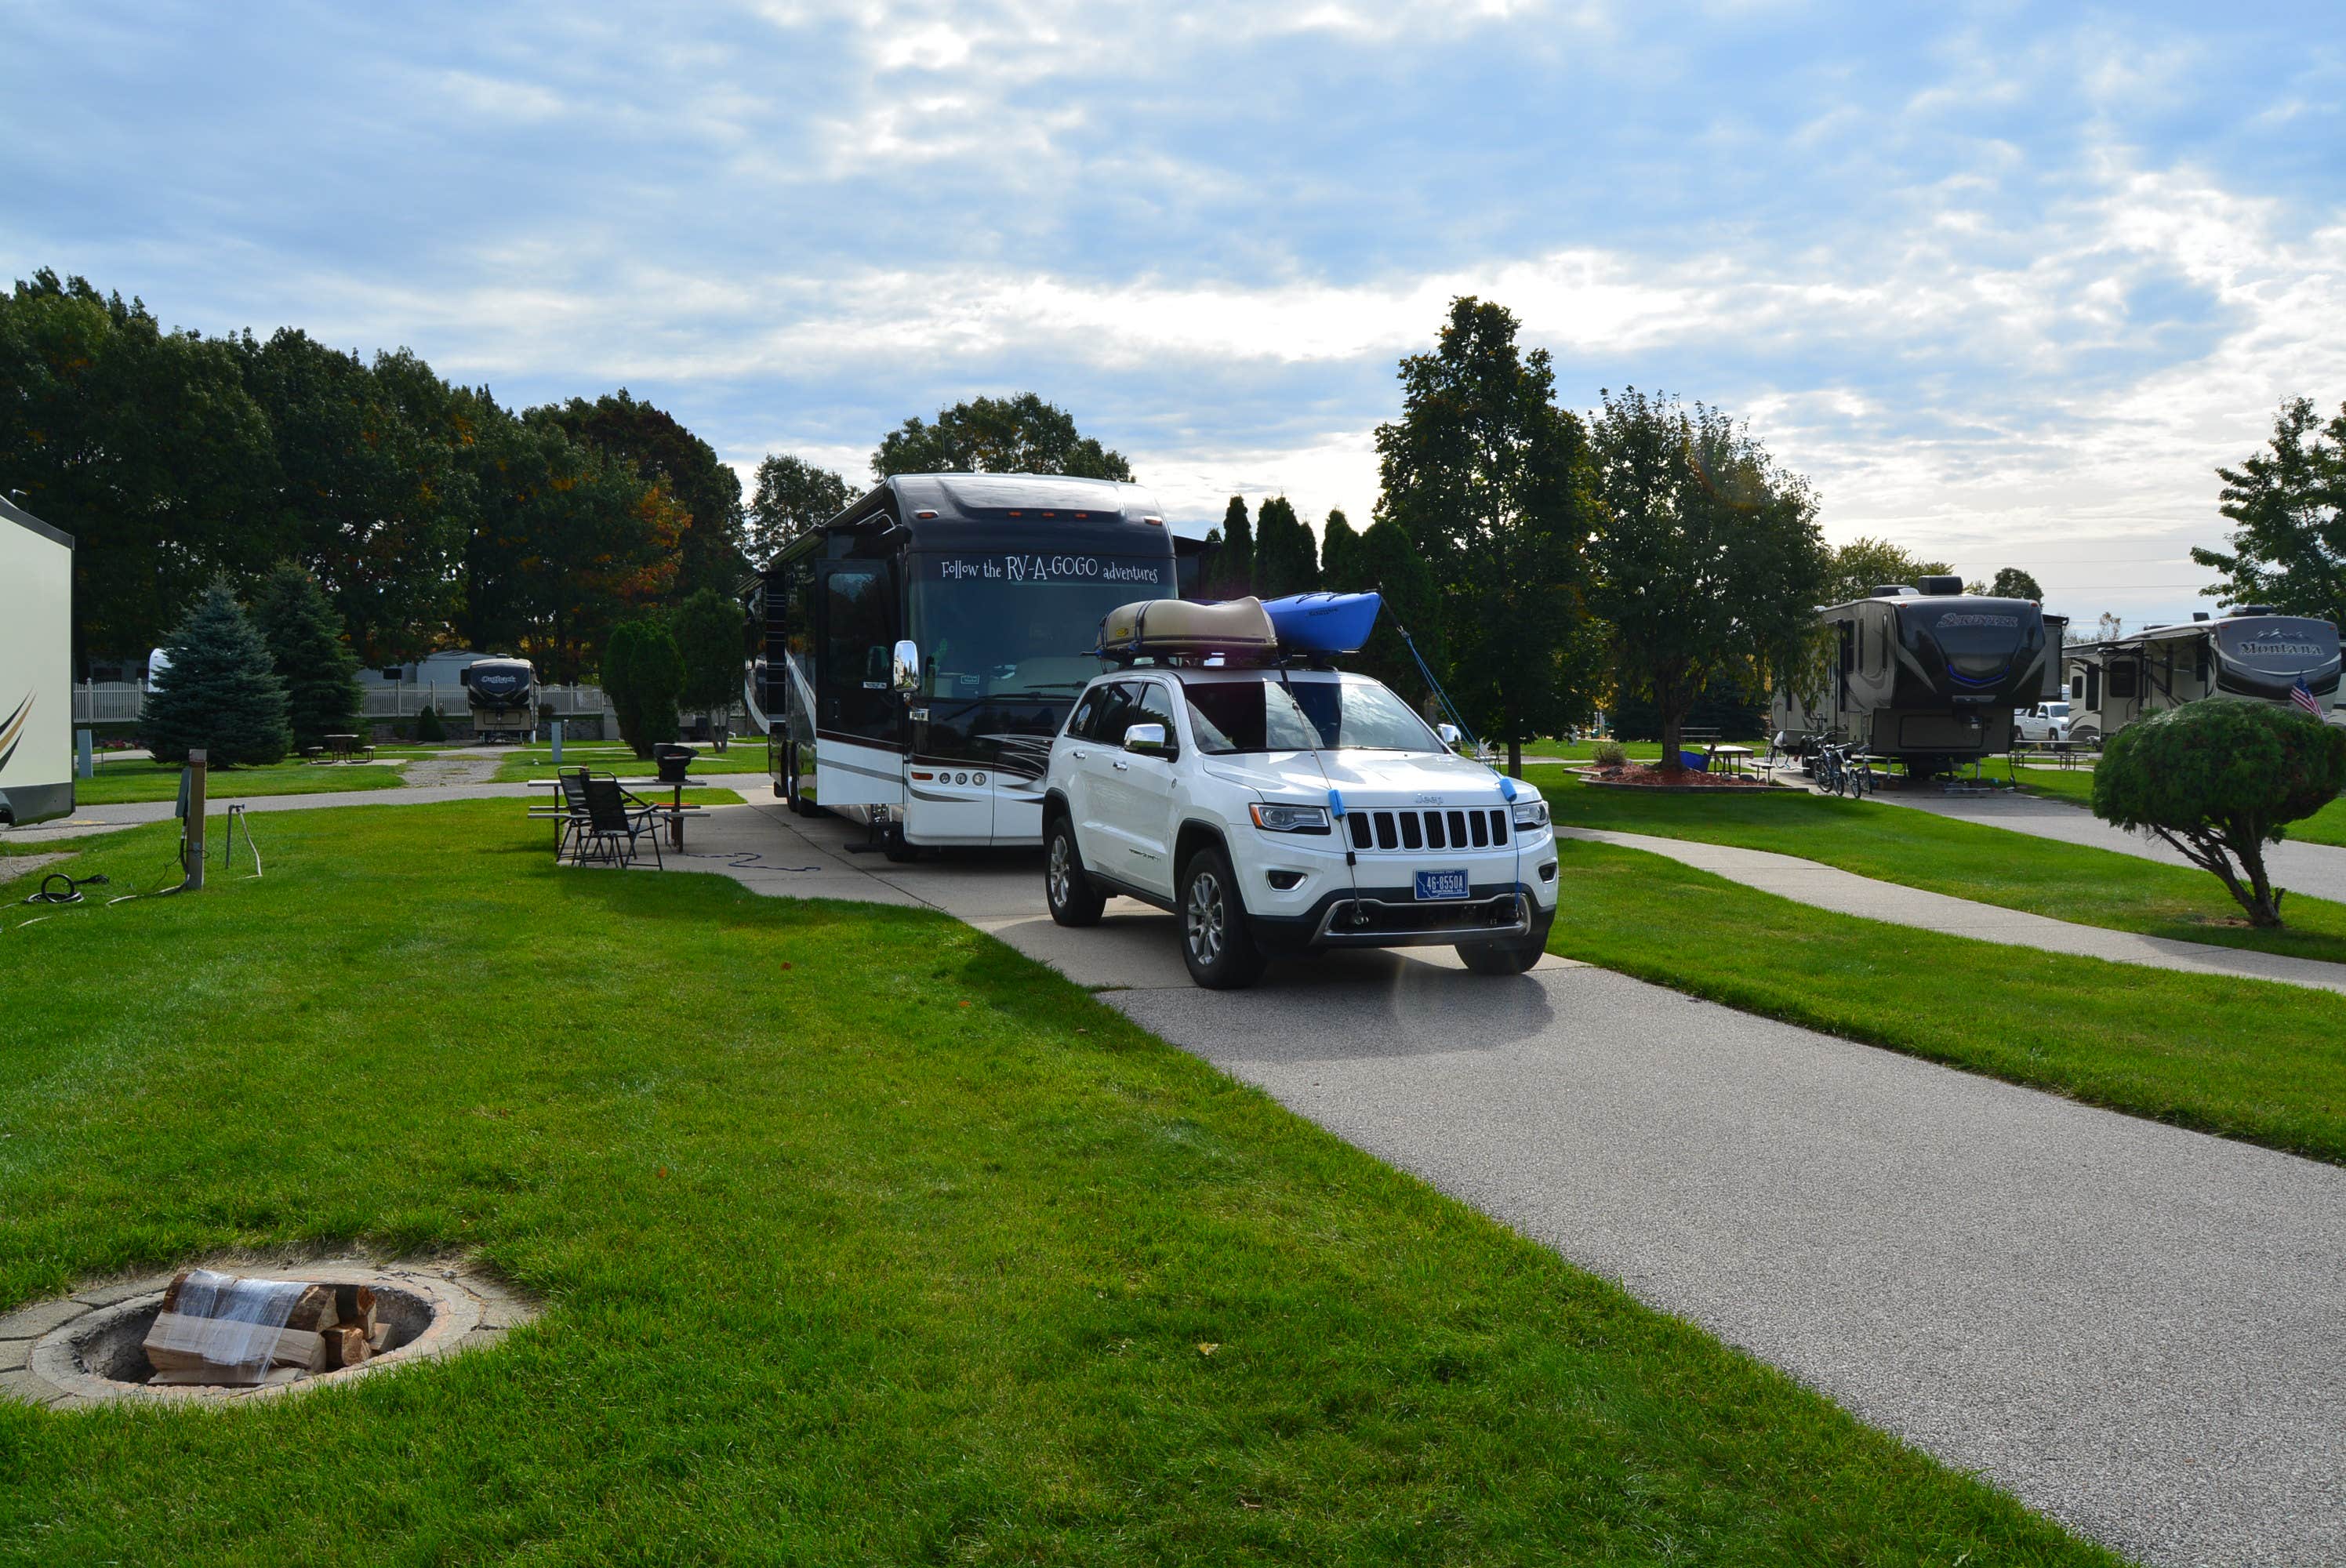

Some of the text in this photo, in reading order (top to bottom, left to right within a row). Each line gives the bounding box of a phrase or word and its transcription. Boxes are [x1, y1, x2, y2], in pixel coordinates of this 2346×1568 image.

[941, 555, 1159, 584] Follow the RV-A-GOGO adventures
[2238, 642, 2326, 655] Montana
[1415, 793, 1444, 805] Jeep
[1426, 875, 1464, 891] 46-8550A
